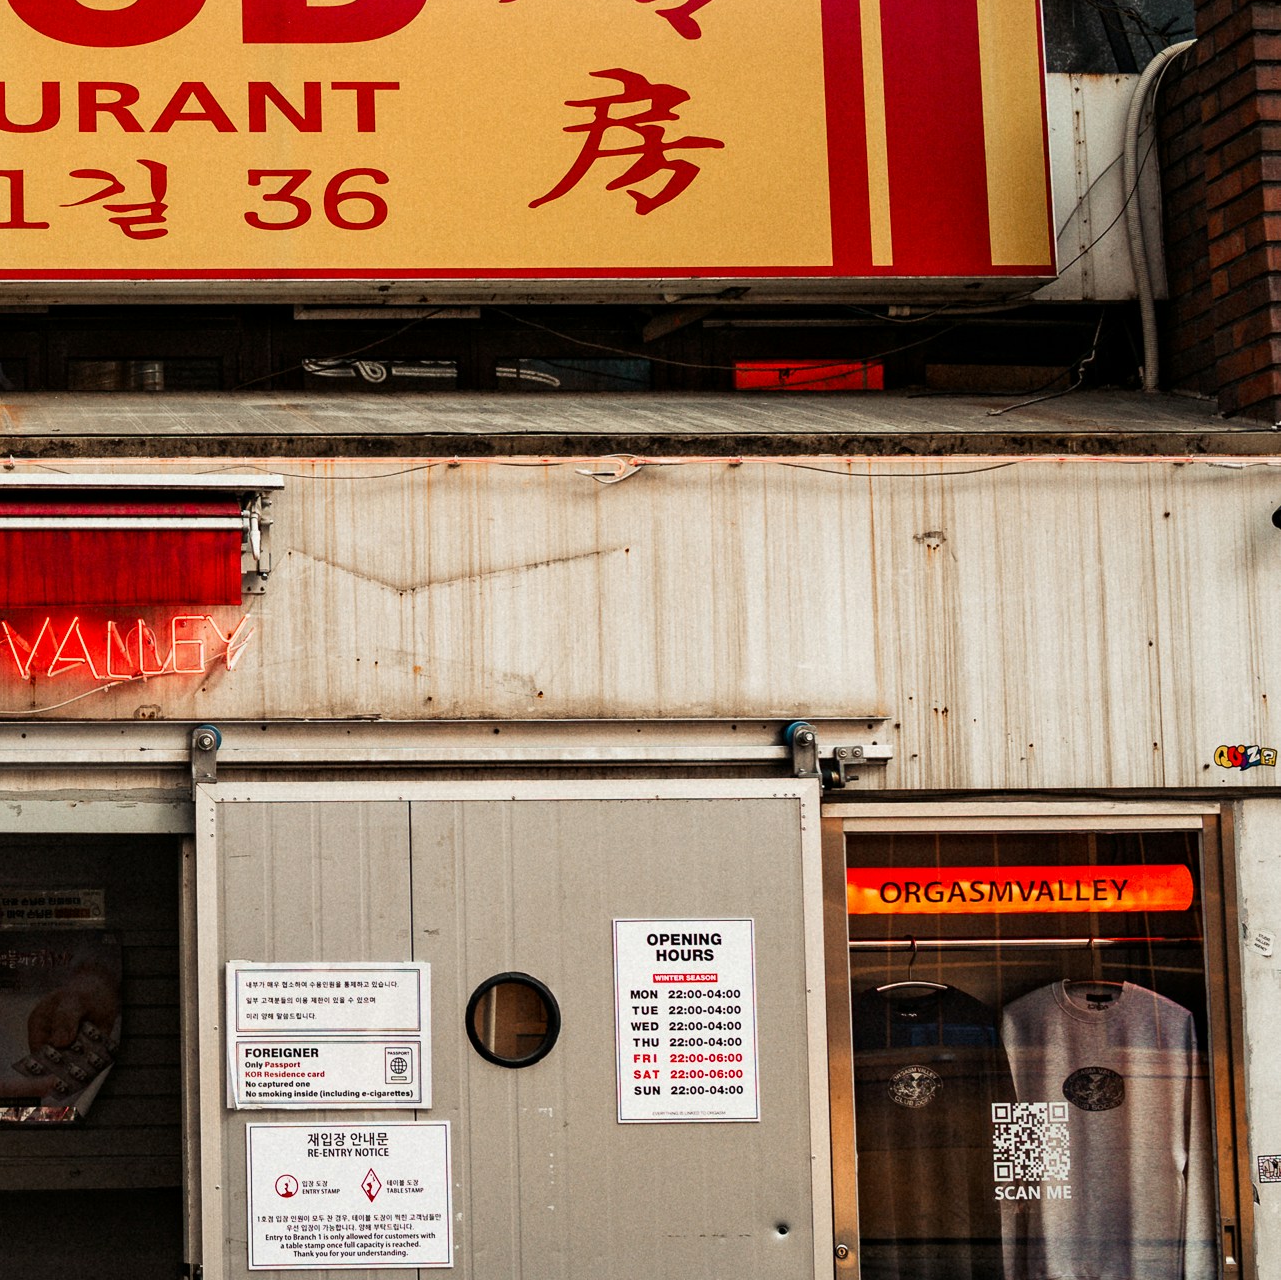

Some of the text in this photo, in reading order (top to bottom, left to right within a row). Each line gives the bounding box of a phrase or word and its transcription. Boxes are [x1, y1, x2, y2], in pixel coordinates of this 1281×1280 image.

[243, 167, 390, 231] 36
[2, 612, 253, 680] VALLEY
[879, 878, 1130, 906] ORGASMVALLEY
[647, 933, 721, 946] OPENING
[656, 949, 714, 961] HOURS
[654, 974, 717, 982] WINTER SEASON
[630, 989, 741, 1000] MON 22:00-04:00
[631, 1005, 742, 1016] TUE 22:00-04:00
[630, 1021, 742, 1032] WED 22:00-04:00
[632, 1037, 743, 1048] THU 22:00-04:00
[244, 1047, 319, 1059] FOREIGNER
[633, 1053, 743, 1064] FRI 22:00-06:00
[244, 1061, 301, 1070] Only Passport
[263, 1070, 306, 1078] Residence
[306, 1070, 326, 1078] card
[633, 1069, 744, 1080] SAT 22:00-06:00
[245, 1080, 257, 1088] No
[257, 1080, 294, 1089] captured
[245, 1089, 414, 1099] No smoking inside (including e-cigarettes)
[633, 1085, 744, 1096] SUN 22:00-04:00
[308, 1133, 388, 1146] 재입장 안내문
[307, 1147, 390, 1158] RE-ENTRY NOTICE
[995, 1185, 1072, 1200] SCAN ME
[265, 1233, 284, 1242] Entry
[292, 1233, 317, 1241] Branch
[323, 1233, 329, 1241] is
[329, 1232, 345, 1242] only
[345, 1232, 373, 1240] allowed
[373, 1232, 384, 1240] for
[285, 1241, 304, 1249] table
[304, 1242, 326, 1250] stamp
[343, 1241, 356, 1249] full
[356, 1241, 384, 1250] capacity
[391, 1240, 422, 1248] reached.
[293, 1249, 409, 1259] Thank you for your understanding.
